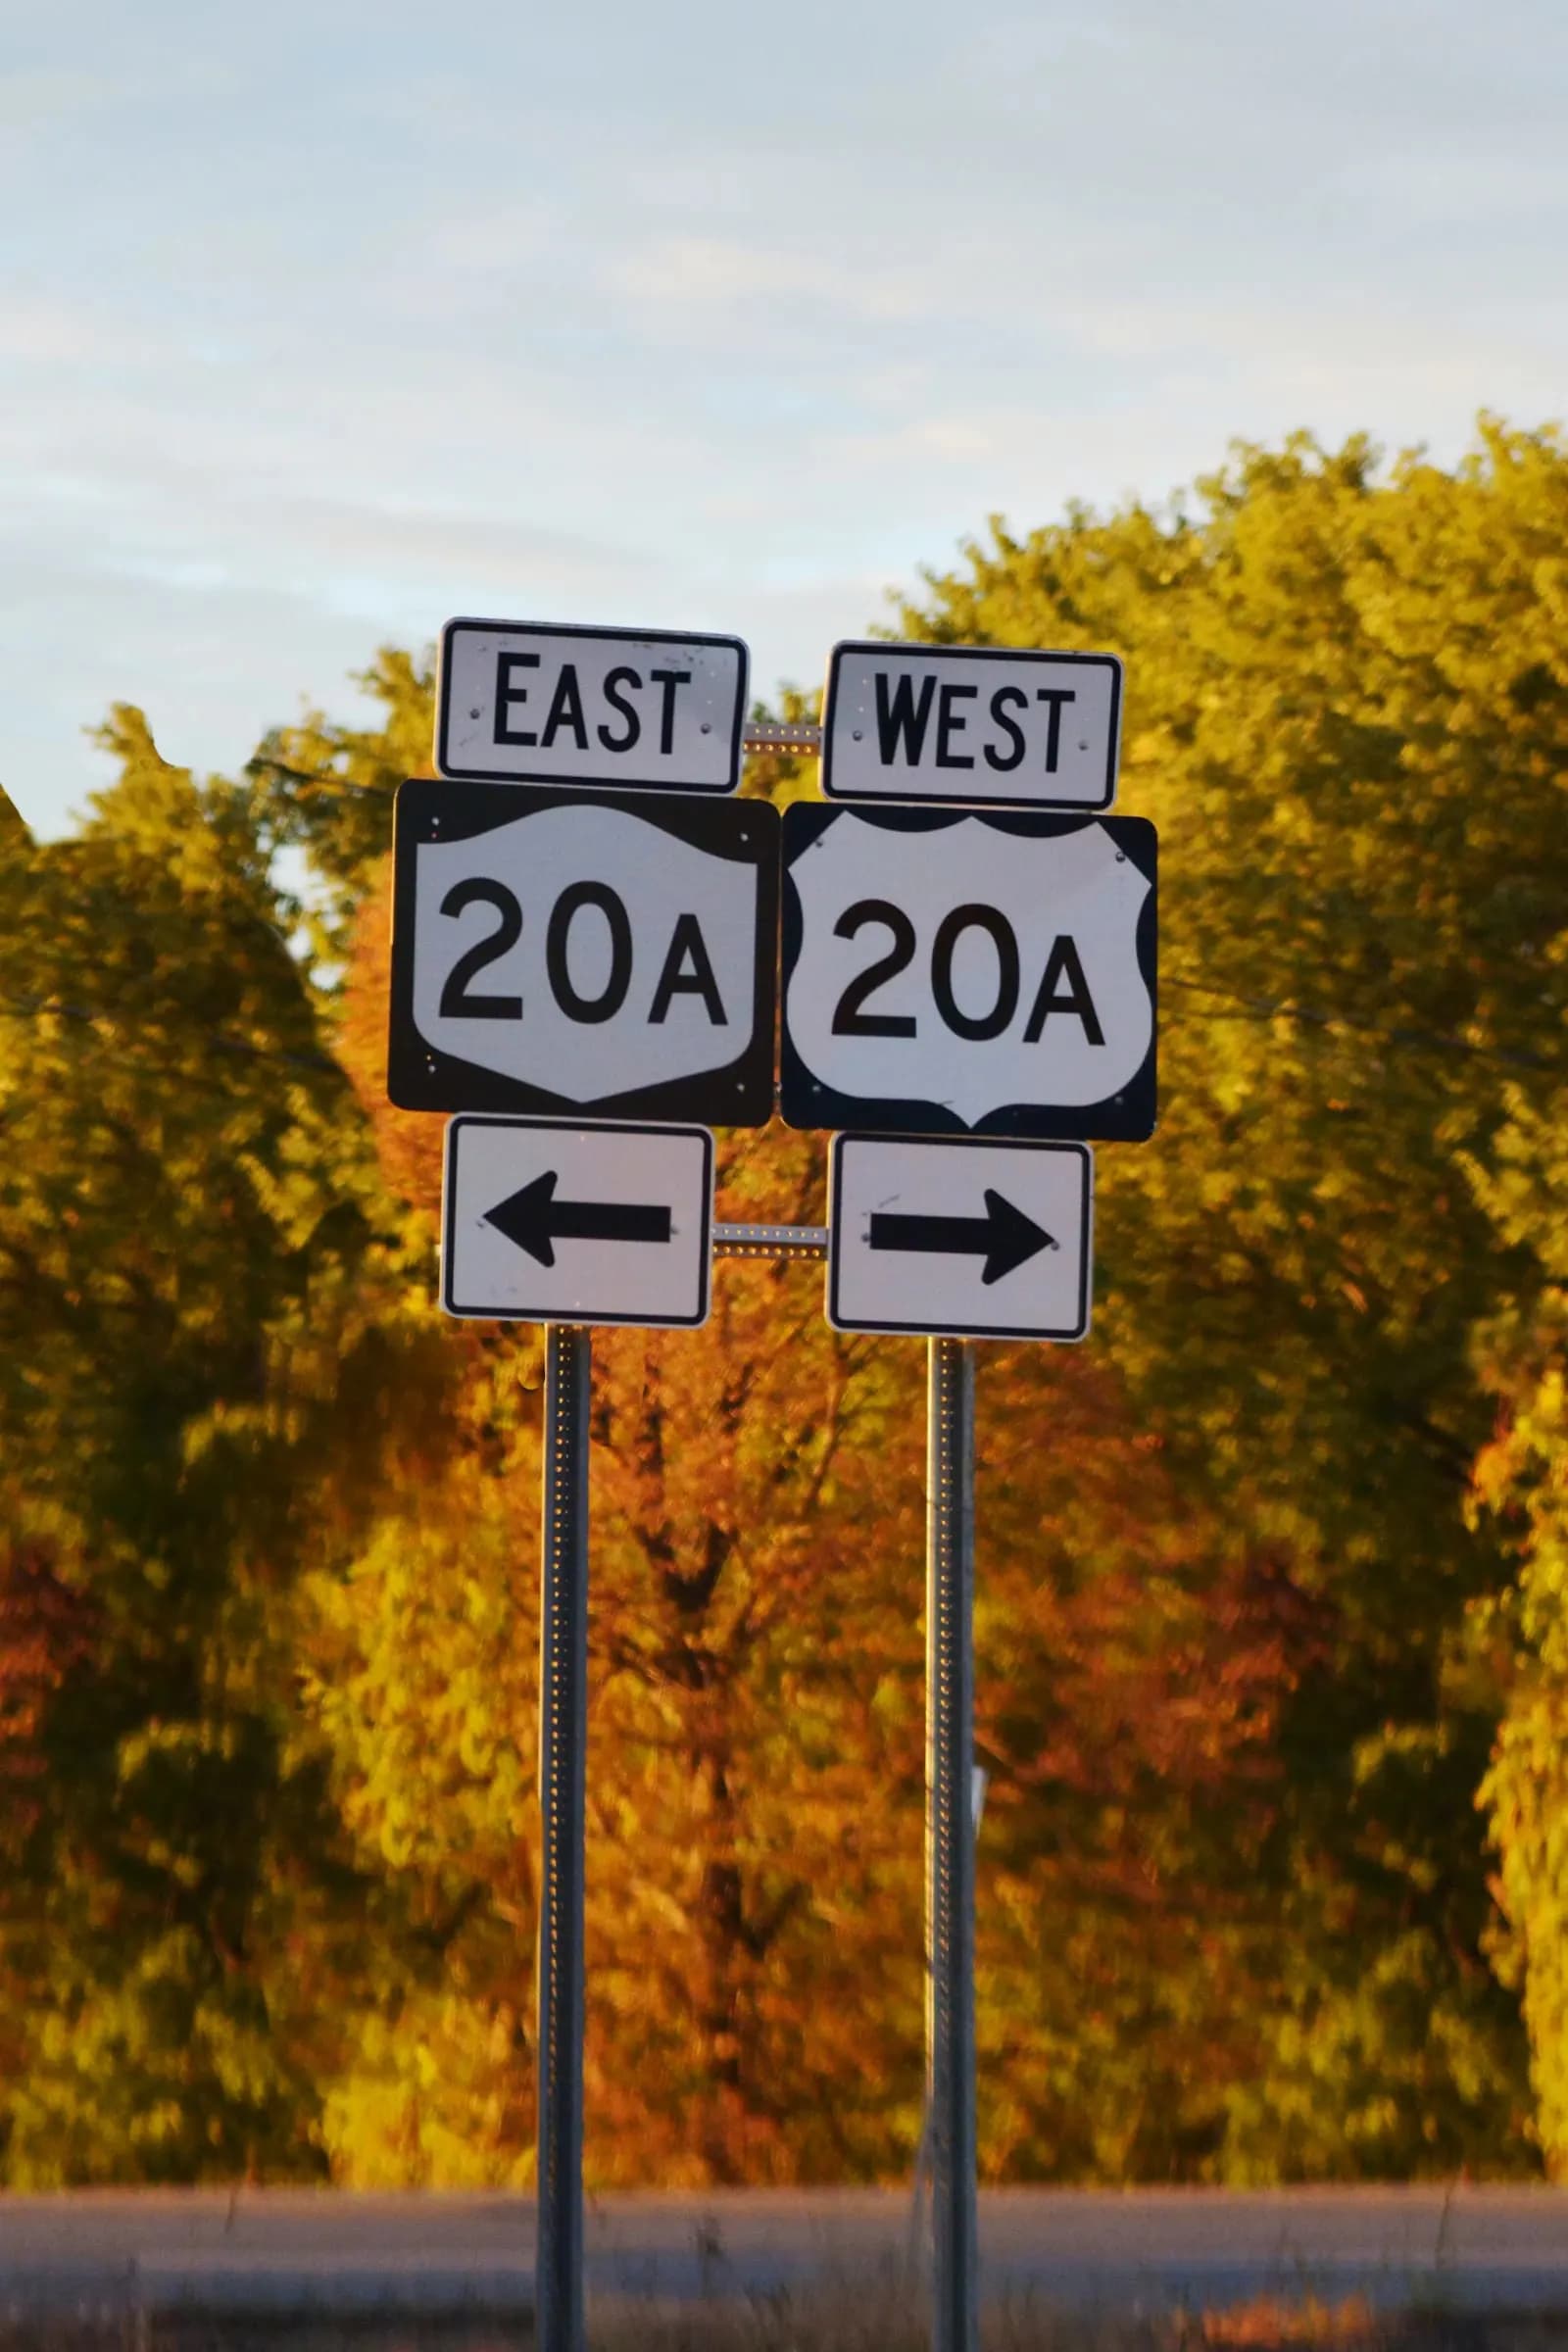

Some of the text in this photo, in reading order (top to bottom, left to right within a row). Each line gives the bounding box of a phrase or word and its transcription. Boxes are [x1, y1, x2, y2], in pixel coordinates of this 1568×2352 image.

[492, 650, 693, 756] EAST
[873, 671, 1077, 774] WEST
[438, 876, 729, 1027] 20A
[830, 898, 1106, 1047] 20A
